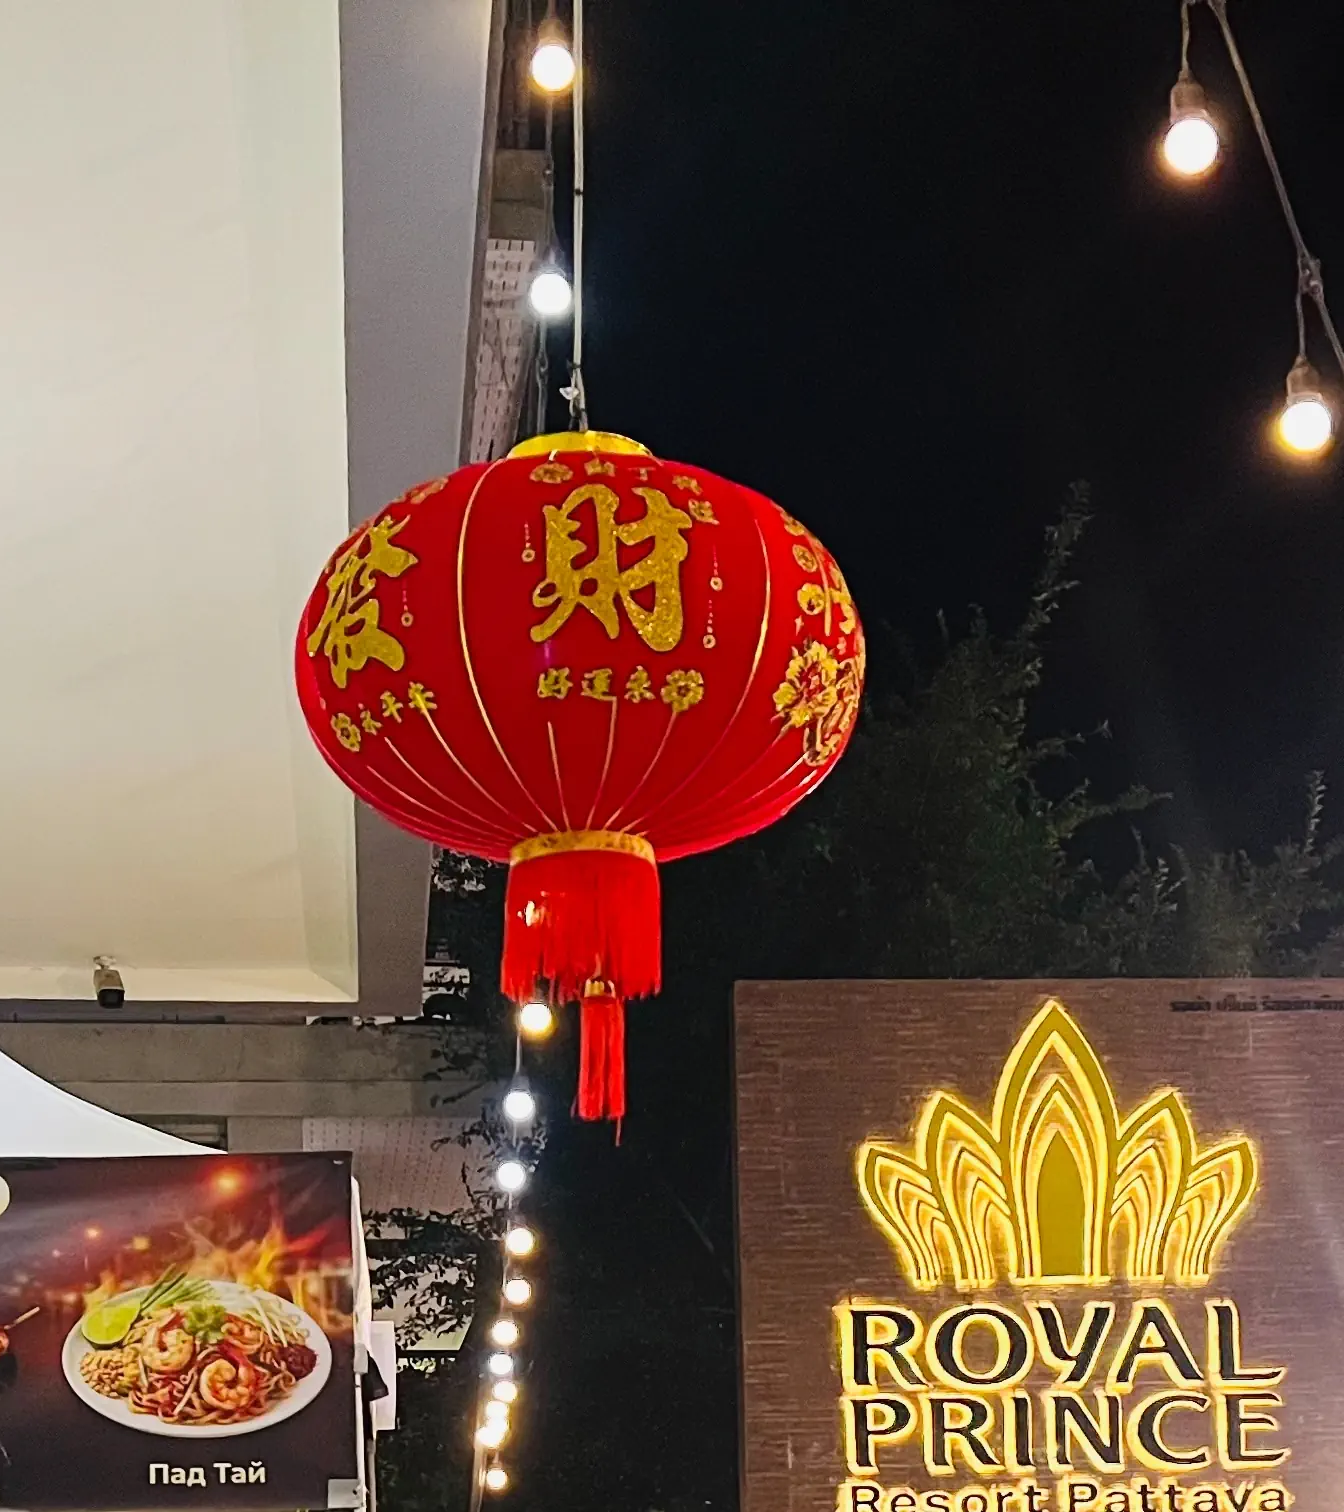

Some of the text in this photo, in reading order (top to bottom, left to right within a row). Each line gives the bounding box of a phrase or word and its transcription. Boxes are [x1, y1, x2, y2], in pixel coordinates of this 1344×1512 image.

[529, 482, 693, 653] 財
[839, 1299, 1288, 1391] ROYAL
[149, 1461, 267, 1488] Пад Тай
[845, 1392, 1290, 1474] PRINCE
